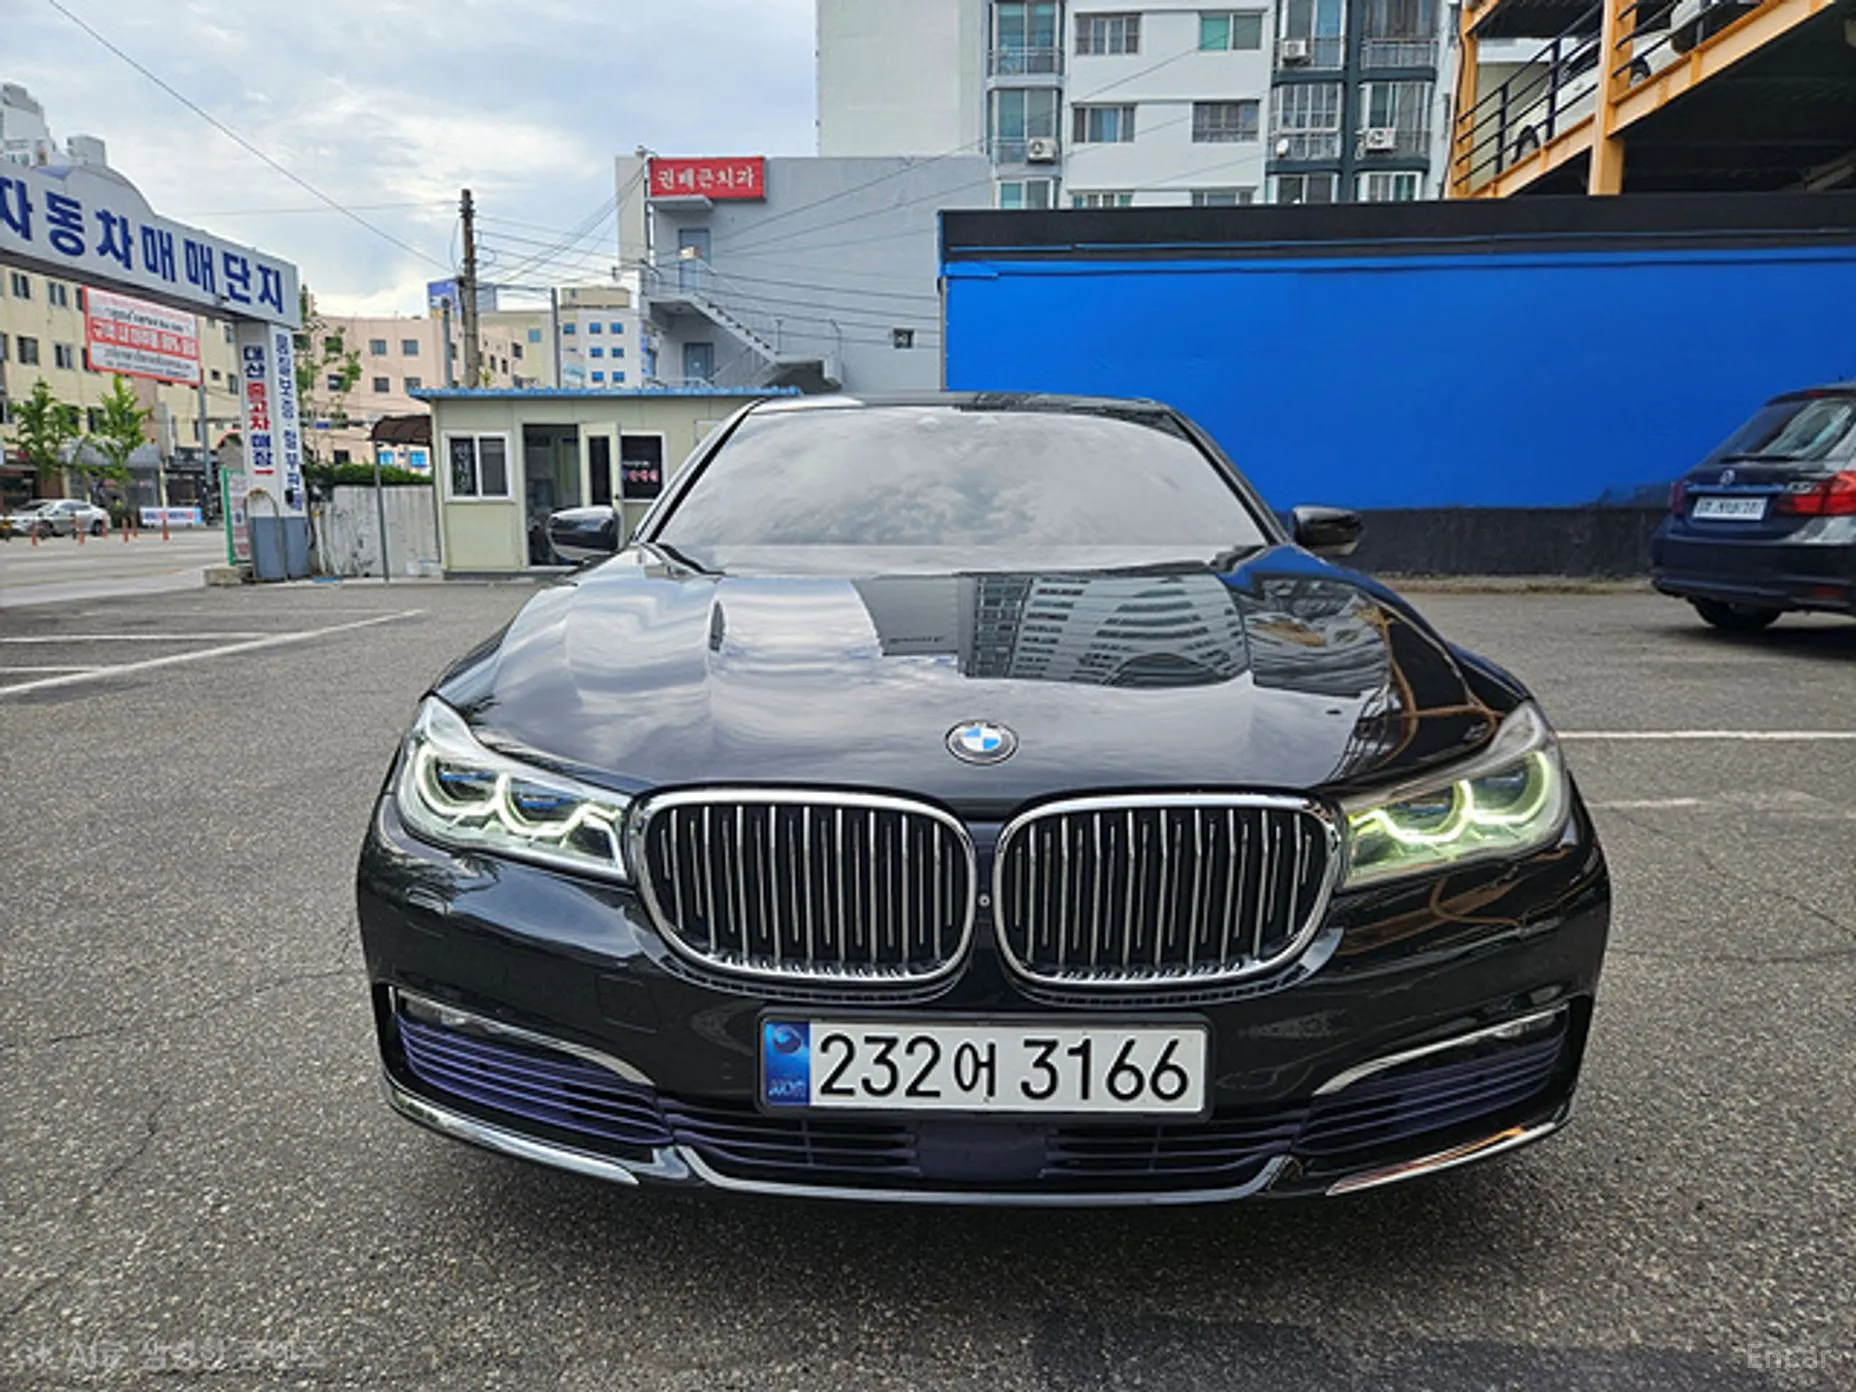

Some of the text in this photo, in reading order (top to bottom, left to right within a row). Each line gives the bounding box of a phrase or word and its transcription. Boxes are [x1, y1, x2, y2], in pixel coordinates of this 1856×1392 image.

[0, 176, 285, 315] 자동차매매단지
[818, 1032, 1189, 1101] 232어 3166
